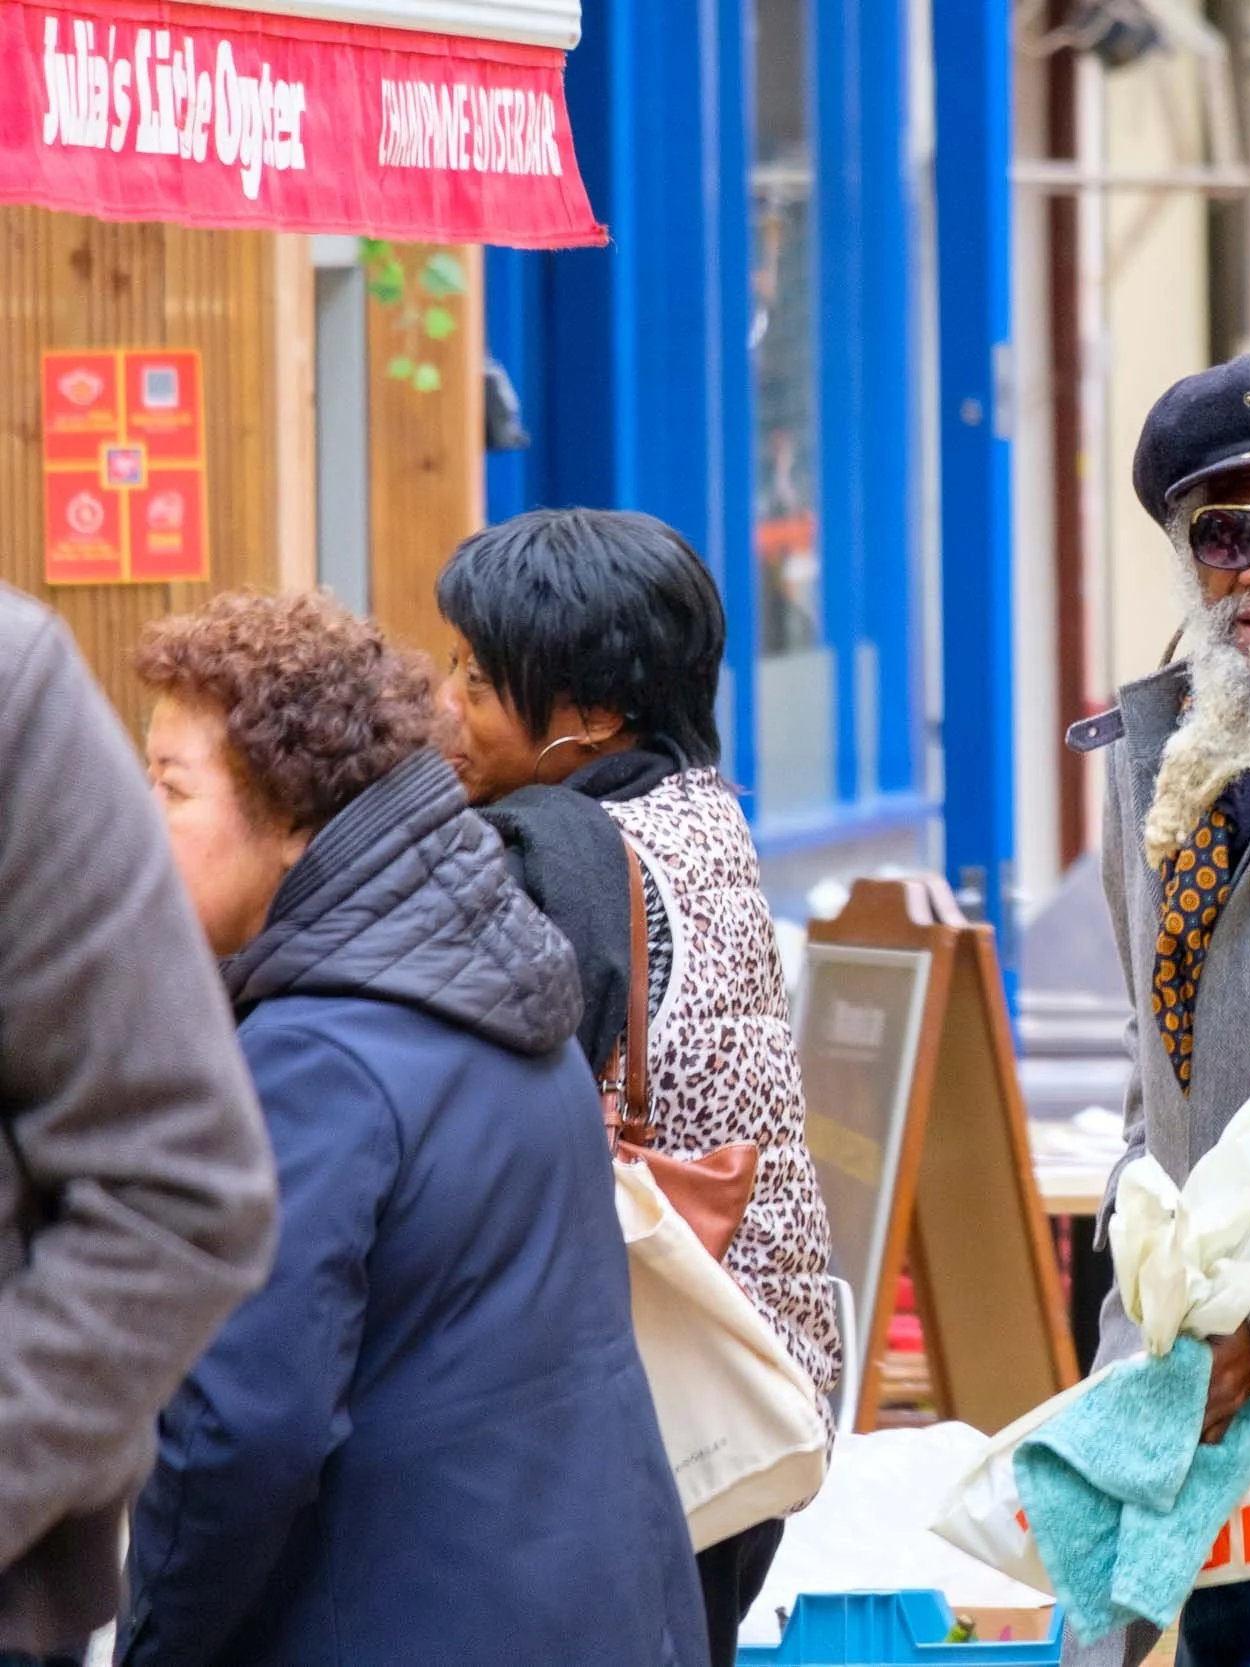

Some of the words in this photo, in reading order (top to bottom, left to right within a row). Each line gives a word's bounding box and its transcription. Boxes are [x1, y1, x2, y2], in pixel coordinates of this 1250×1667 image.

[43, 16, 131, 153] Julia's
[135, 28, 212, 164] Litle
[215, 39, 306, 200] Oyter
[378, 79, 470, 170] CHAMPNE
